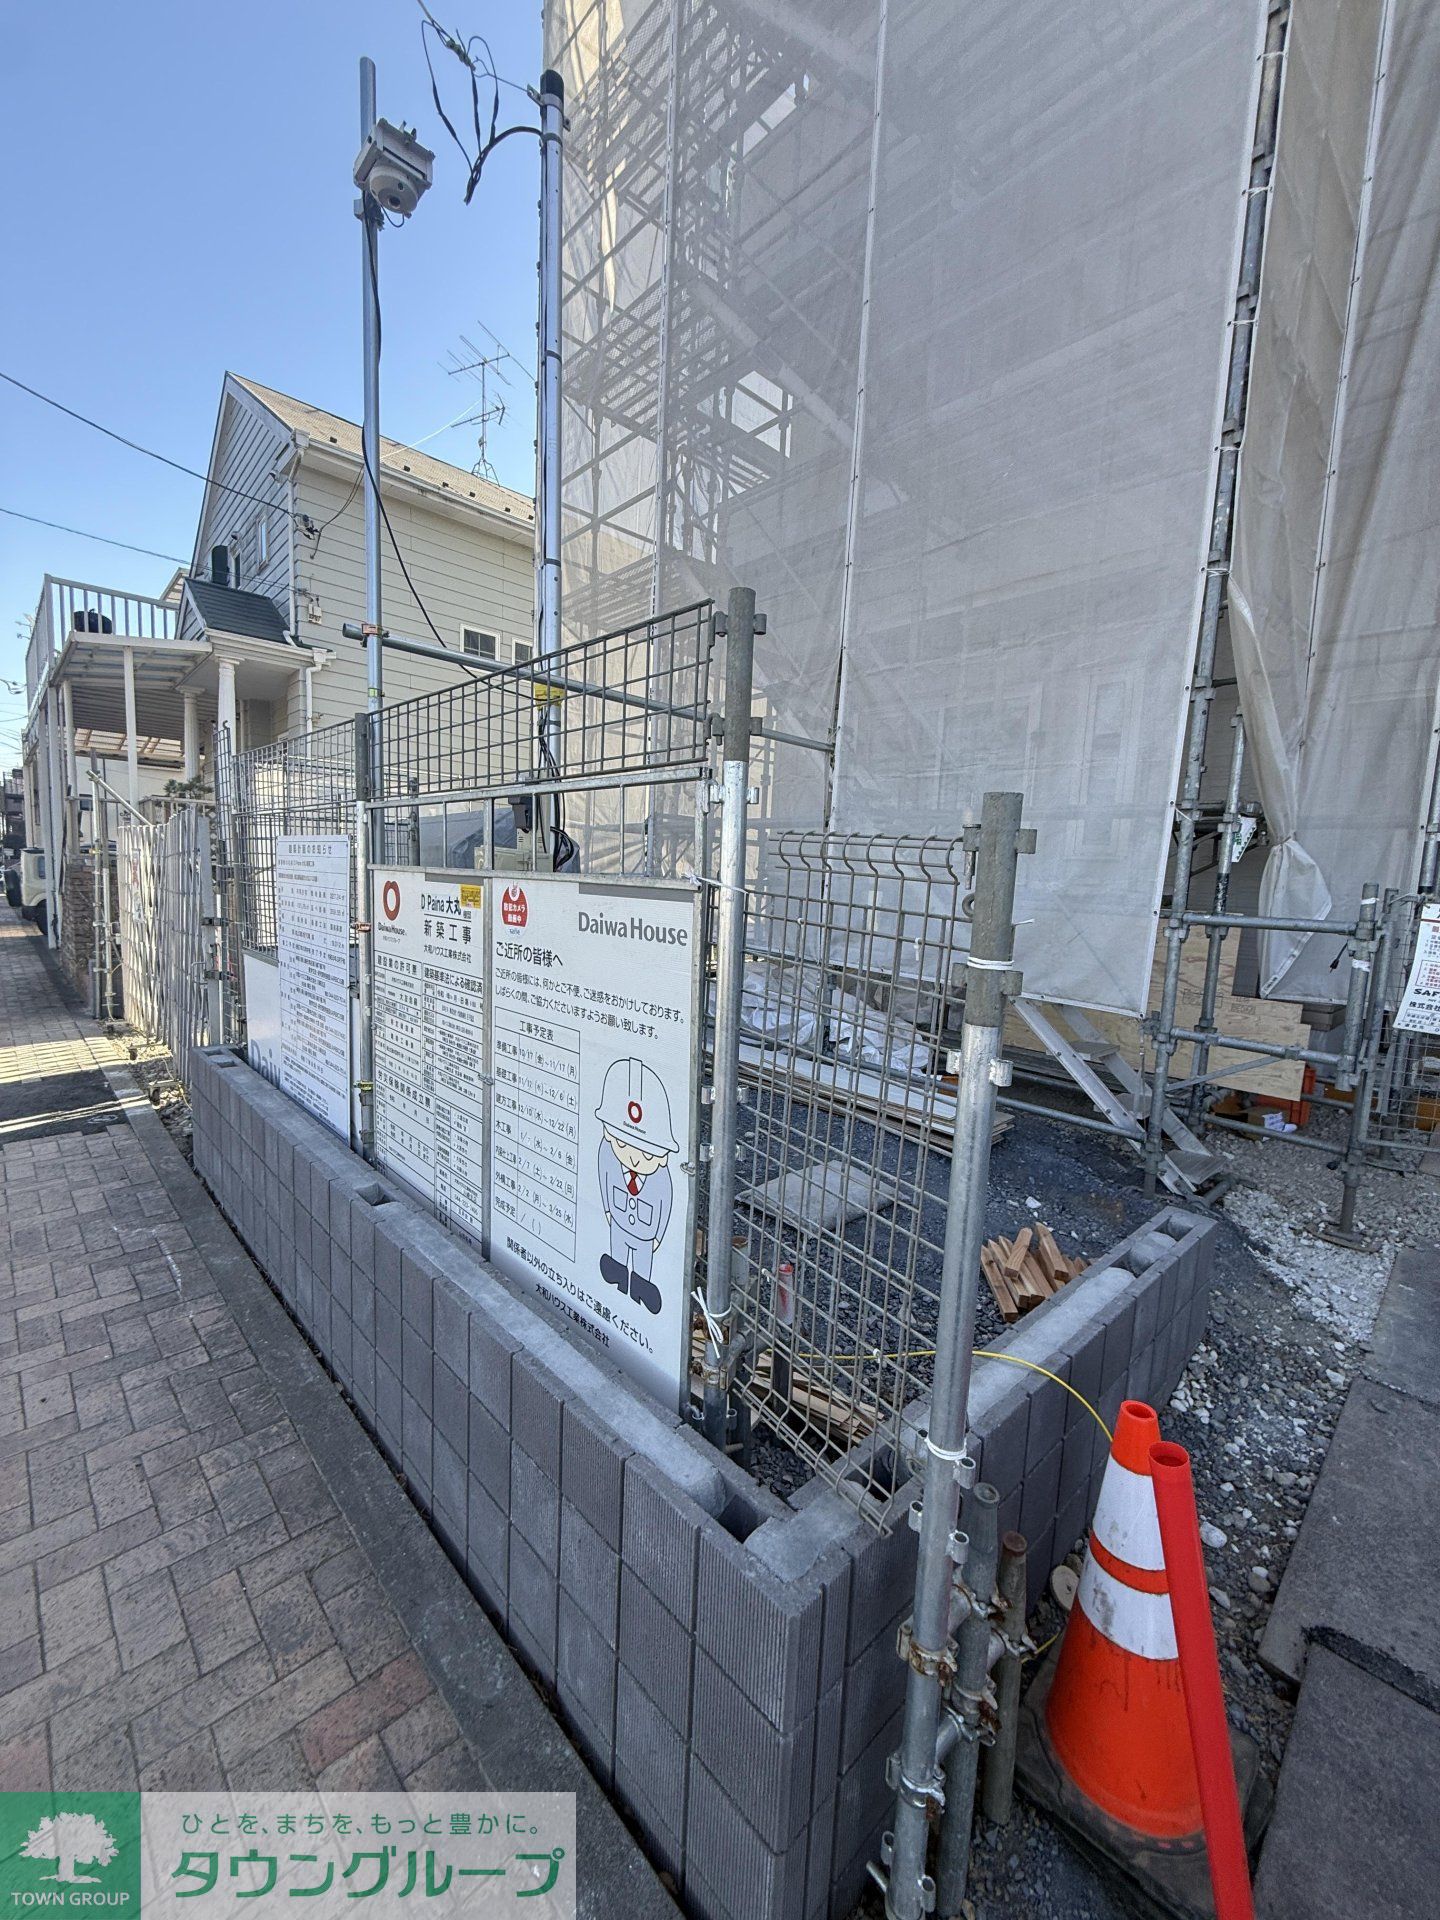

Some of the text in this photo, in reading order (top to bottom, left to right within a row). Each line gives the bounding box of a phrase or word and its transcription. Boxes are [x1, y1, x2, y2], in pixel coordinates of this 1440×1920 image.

[424, 919, 471, 944] 新築工事
[578, 911, 689, 947] Daiwa House
[496, 941, 564, 968] ご近所の皆様へ
[520, 1020, 554, 1041] 工事予定表
[496, 1120, 512, 1135] 木工事
[535, 1283, 610, 1349] 大和ハウス工業株式会社
